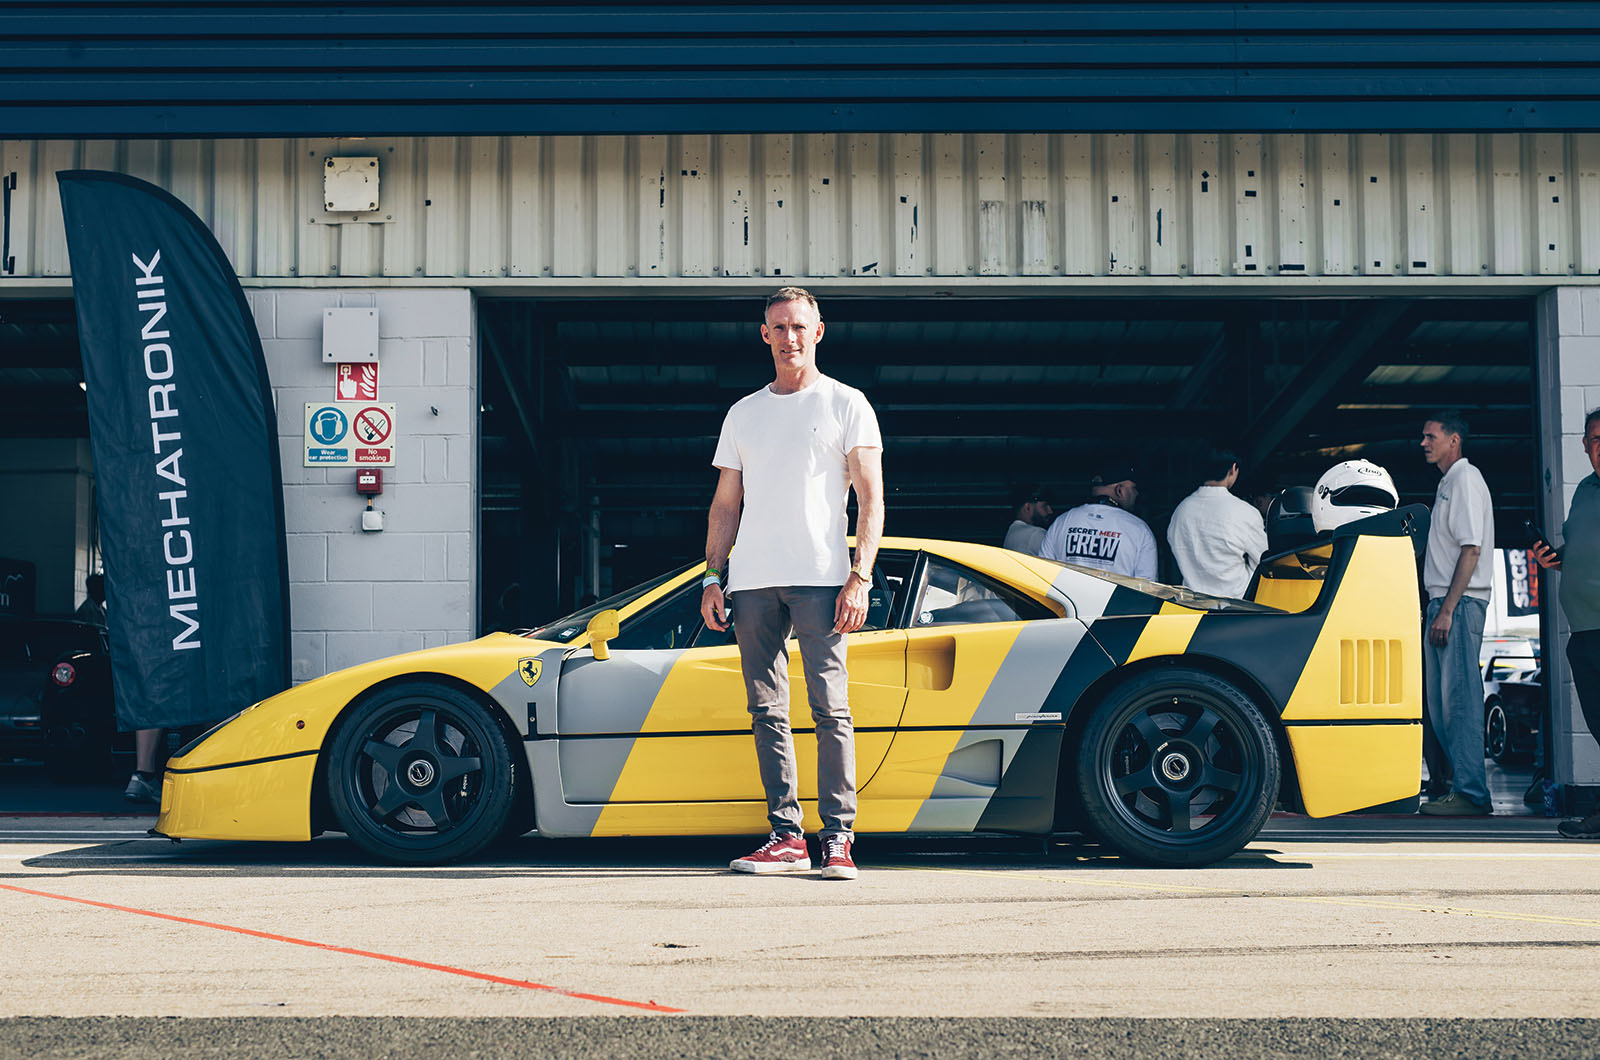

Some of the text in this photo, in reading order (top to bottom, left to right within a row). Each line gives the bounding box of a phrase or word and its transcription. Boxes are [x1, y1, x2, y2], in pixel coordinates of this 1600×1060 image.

[132, 248, 201, 650] MECHATRONIK
[1068, 527, 1122, 538] SECRET MEET
[1067, 534, 1119, 558] CREW
